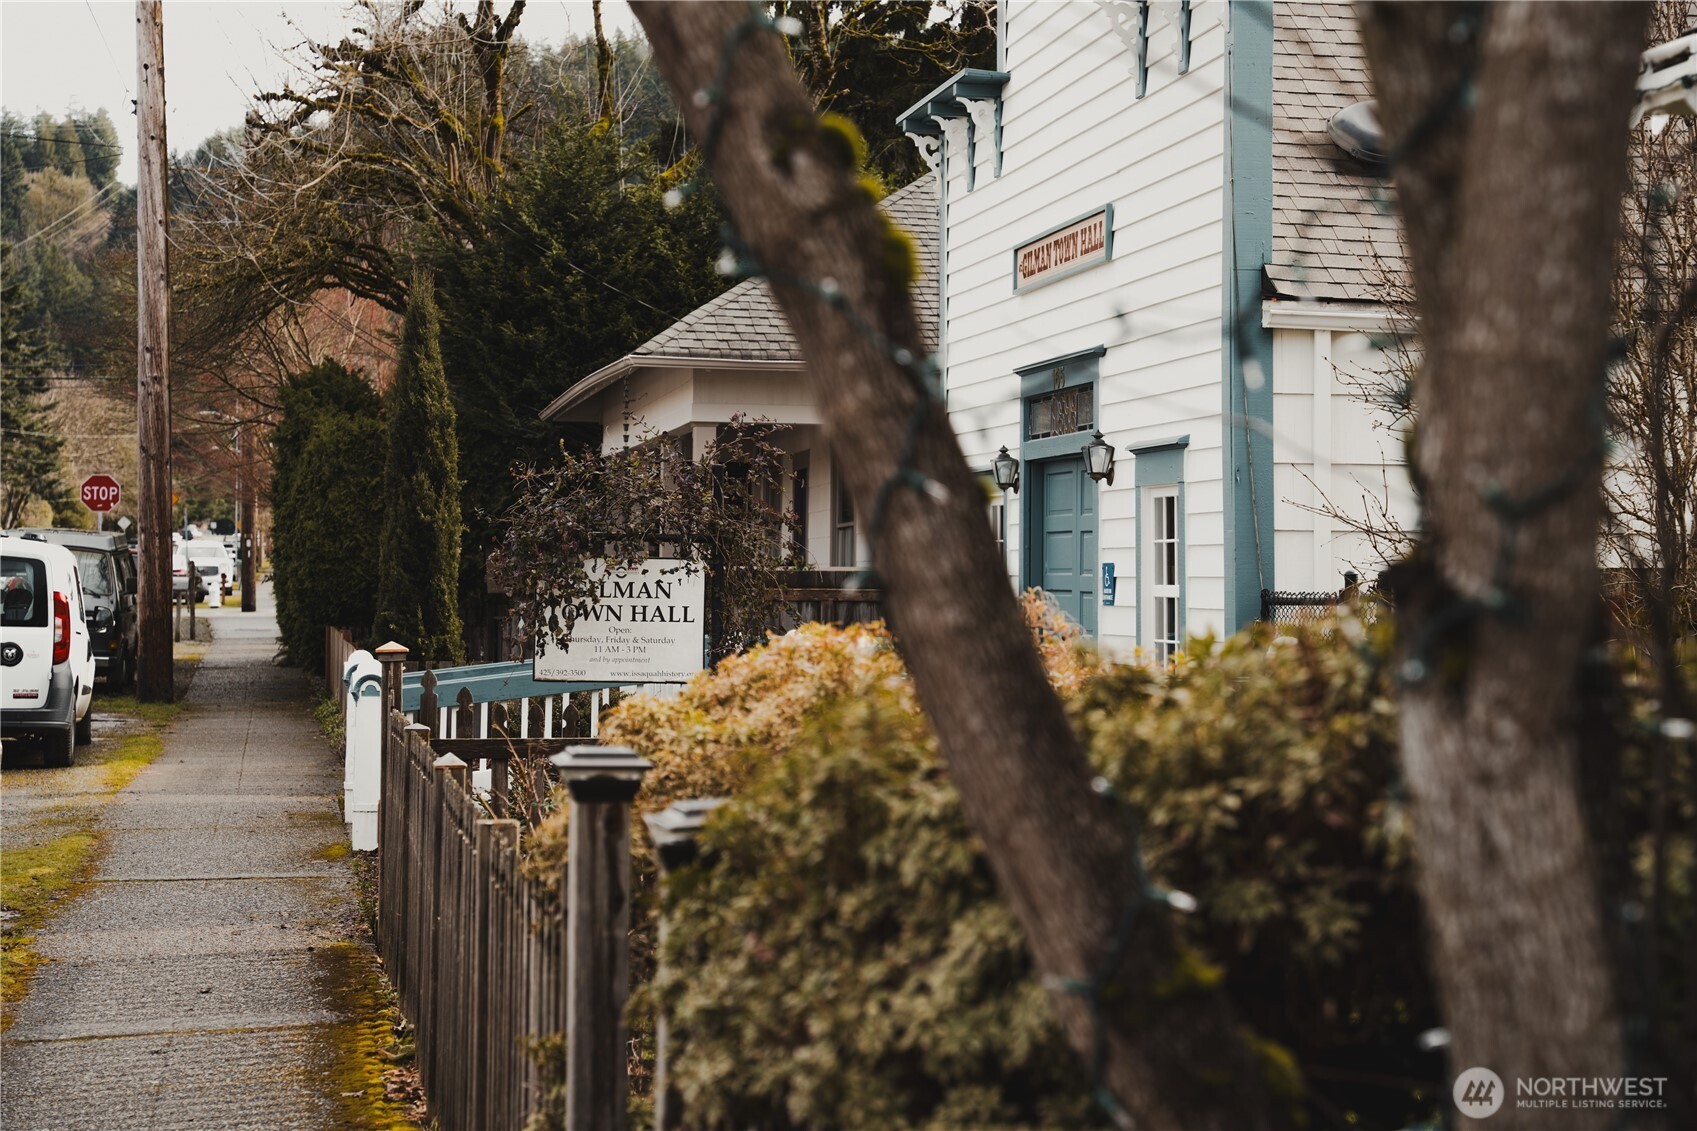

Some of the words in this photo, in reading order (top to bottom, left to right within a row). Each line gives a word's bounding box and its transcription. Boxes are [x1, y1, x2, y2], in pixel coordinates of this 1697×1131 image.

[1022, 242, 1052, 279] GILMAN
[1053, 231, 1079, 267] TOWN
[1080, 220, 1104, 256] HALL
[83, 486, 118, 501] STOP
[553, 603, 624, 622] OWN
[630, 604, 696, 623] HALL
[608, 625, 633, 636] Open:
[605, 635, 631, 646] Friday
[632, 636, 639, 644] &
[640, 636, 676, 647] Saturday
[594, 645, 602, 653] 11
[604, 645, 620, 653] AM
[589, 656, 601, 664] and
[602, 655, 611, 665] by
[611, 656, 651, 665] appointment
